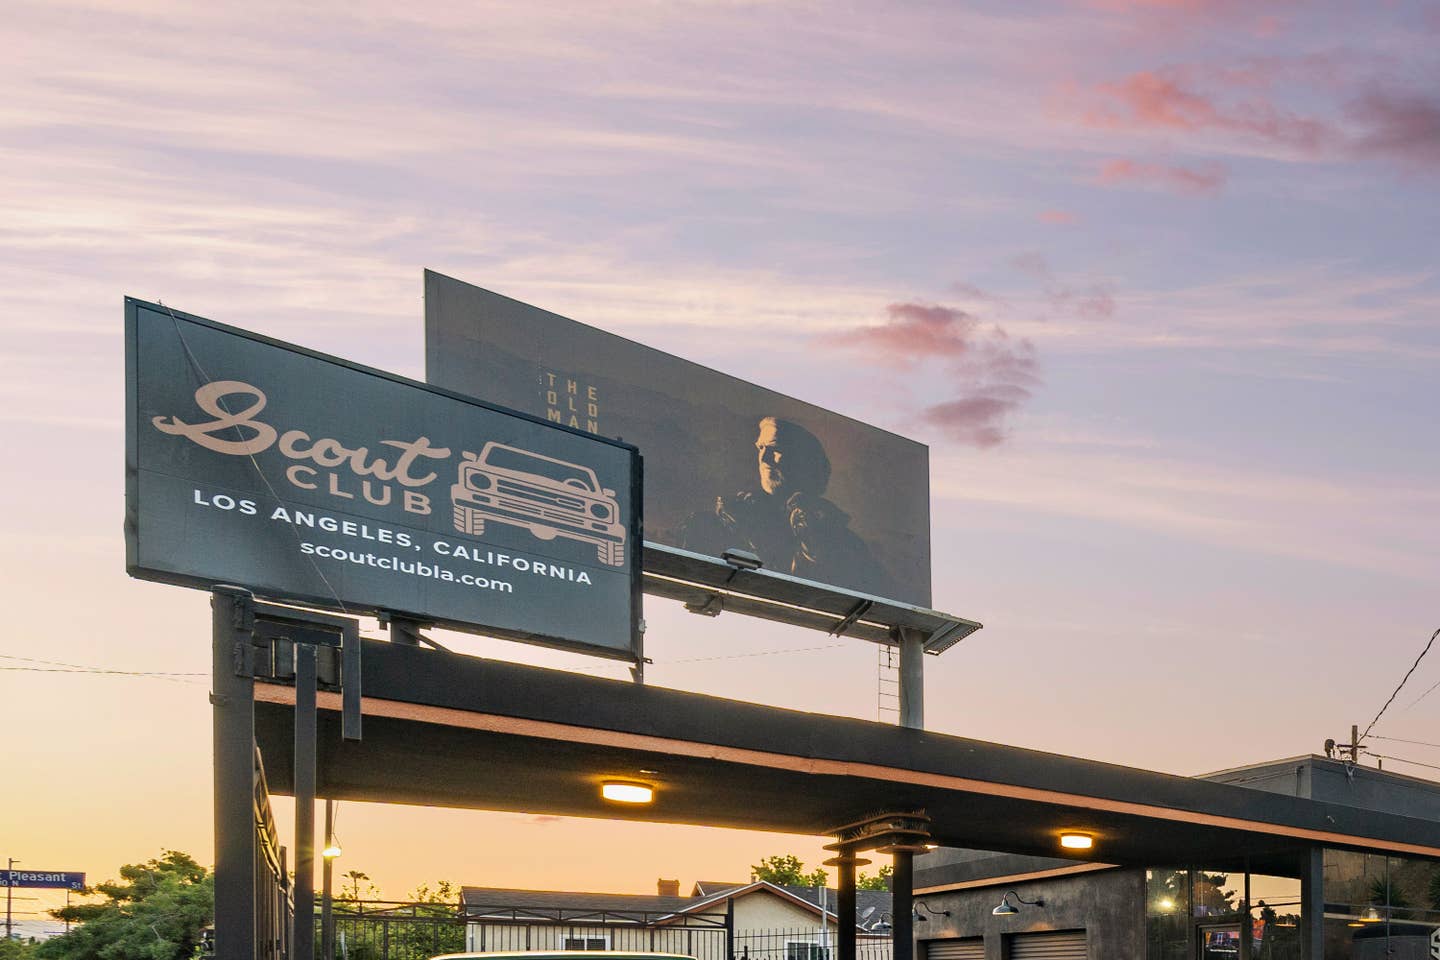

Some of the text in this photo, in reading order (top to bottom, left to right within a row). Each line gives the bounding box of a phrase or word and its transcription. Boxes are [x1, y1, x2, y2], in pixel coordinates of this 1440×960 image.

[547, 372, 597, 401] THE
[547, 390, 598, 418] OLD
[151, 380, 451, 487] Scout
[547, 408, 598, 434] MAN
[286, 465, 432, 515] CLUB
[193, 489, 592, 585] LOS ANGELES, CALIFORNIA
[299, 542, 513, 594] scoutclubla.com
[9, 871, 66, 882] Pleasant
[71, 881, 81, 889] St
